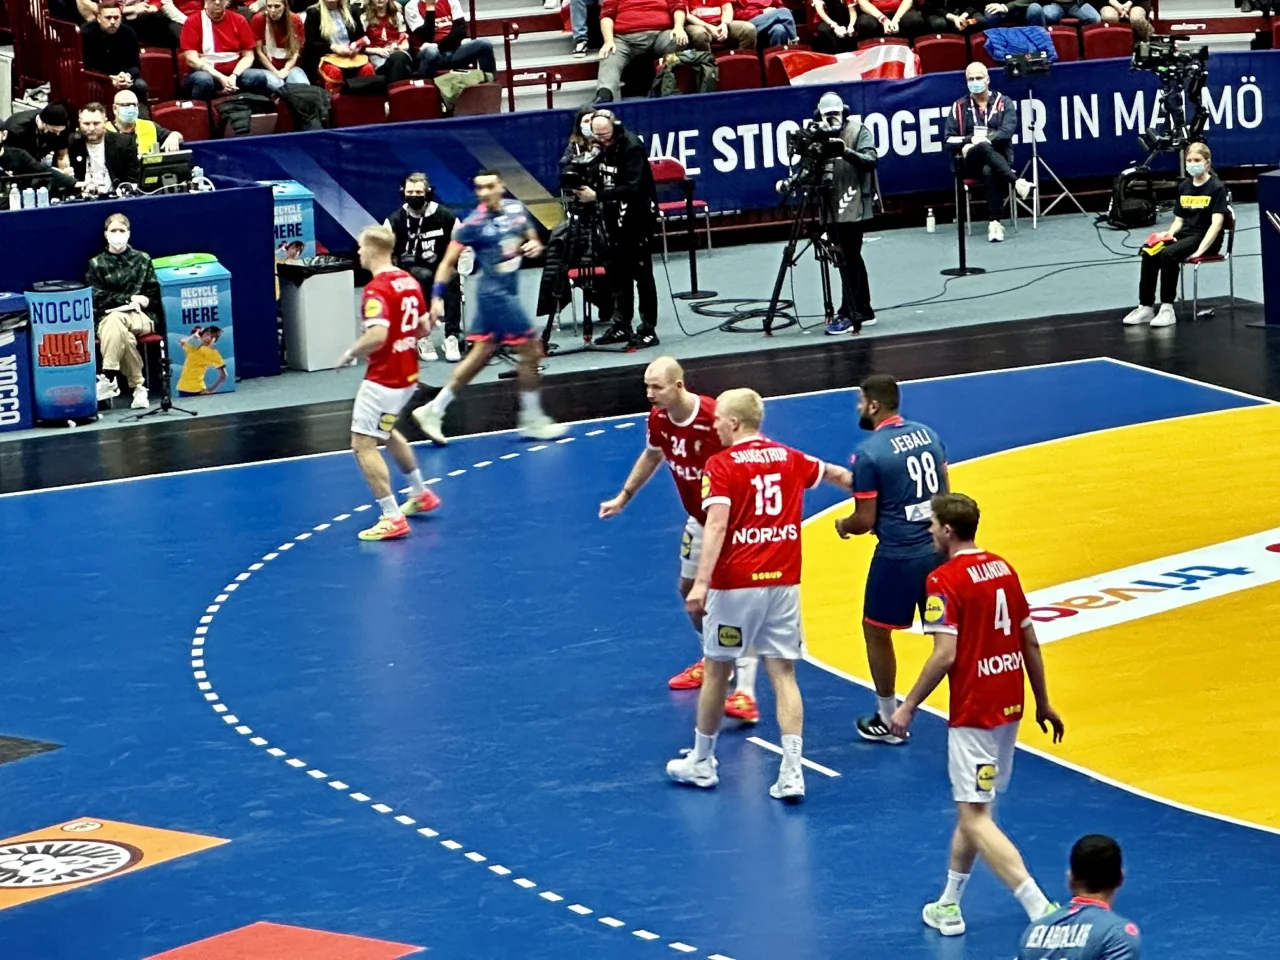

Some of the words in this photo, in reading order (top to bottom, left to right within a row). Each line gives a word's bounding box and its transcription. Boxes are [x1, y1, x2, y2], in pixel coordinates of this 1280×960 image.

[712, 119, 812, 173] STIC
[1060, 93, 1100, 141] IN
[1114, 76, 1263, 137] MAMÖ
[274, 204, 302, 214] ECYCLE
[274, 213, 303, 224] ARTONS
[181, 285, 219, 299] RECYCLE
[181, 296, 219, 308] CARTONS
[32, 297, 91, 325] NOCCO
[182, 305, 220, 325] HERE
[38, 330, 90, 356] JUICY
[0, 353, 21, 425] NOCCO
[671, 436, 687, 458] 34
[891, 428, 932, 454] JEBALI
[907, 451, 939, 499] 98
[751, 473, 784, 516] 15
[732, 524, 798, 545] NORLYS
[1030, 565, 1255, 623] trivag
[994, 588, 1012, 636] 4
